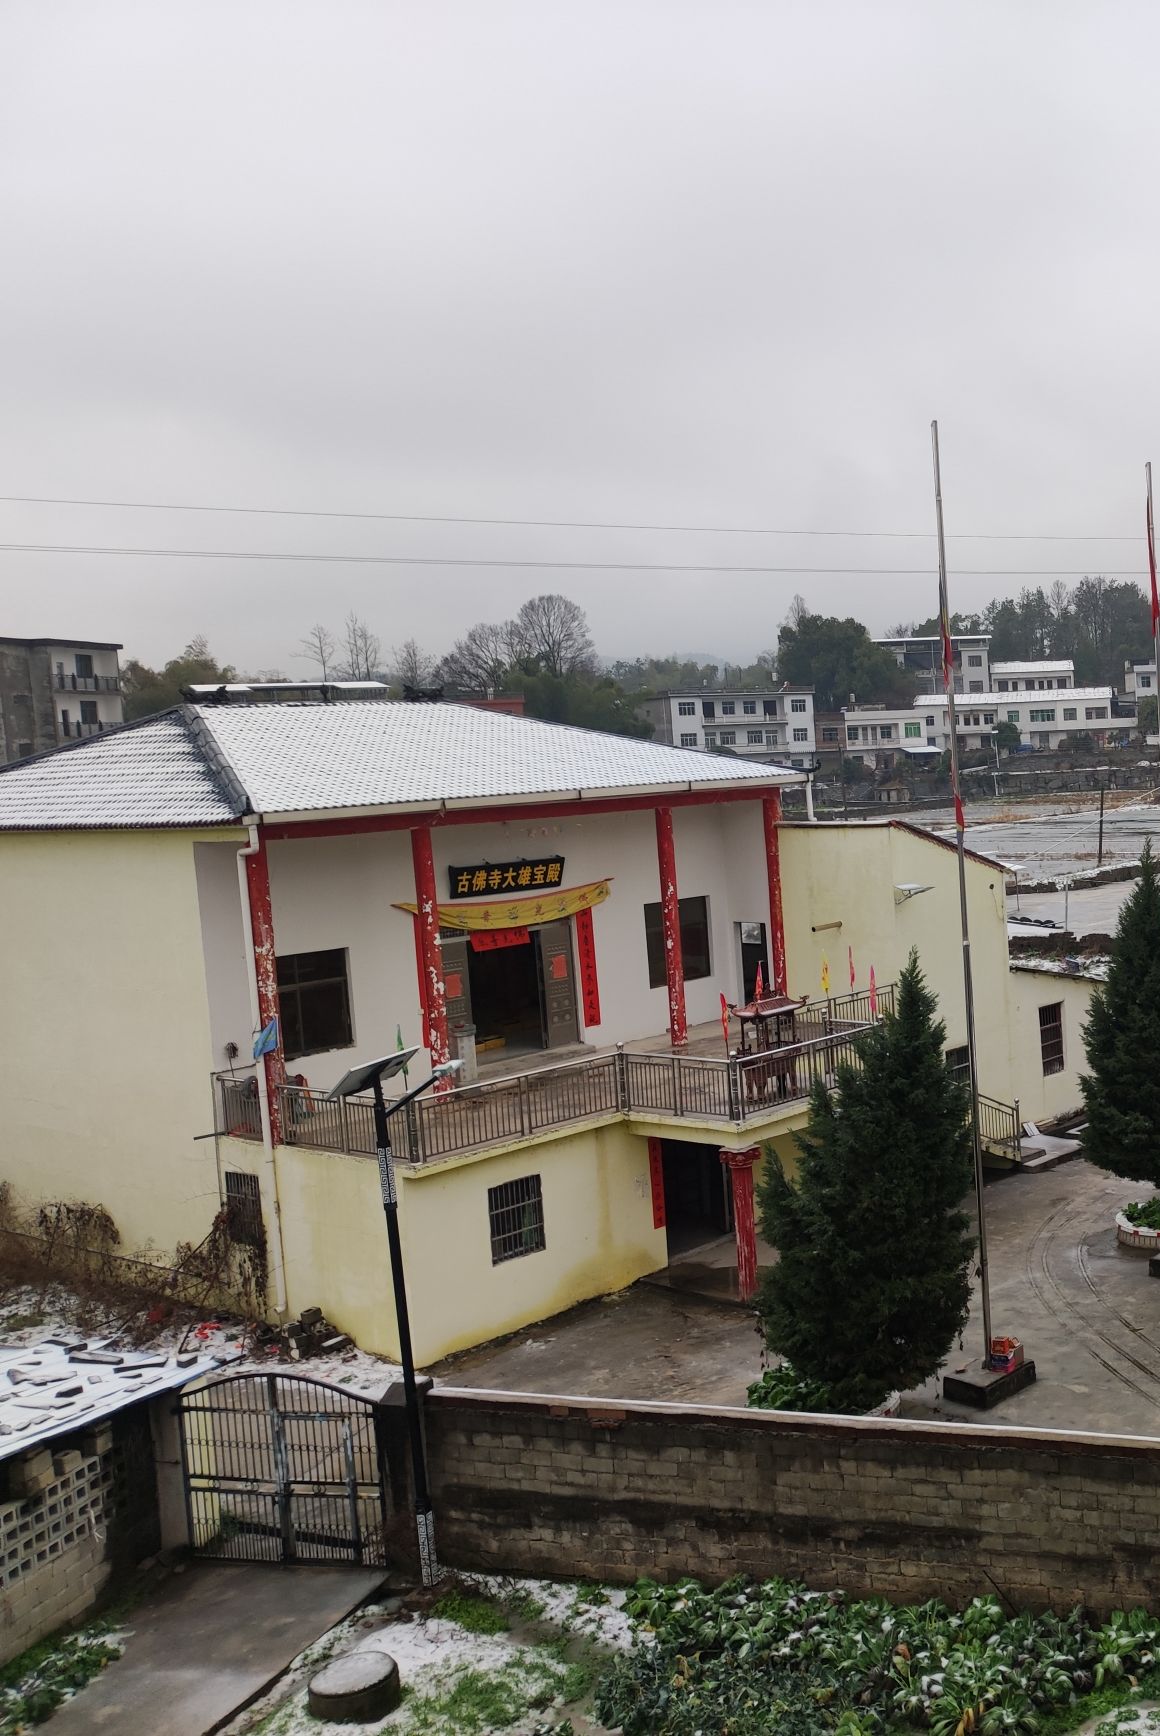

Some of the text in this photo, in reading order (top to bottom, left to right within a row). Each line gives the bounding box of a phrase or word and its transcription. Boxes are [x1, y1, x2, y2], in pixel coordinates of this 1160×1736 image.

[456, 862, 561, 894] 古佛寺大雄宝殿
